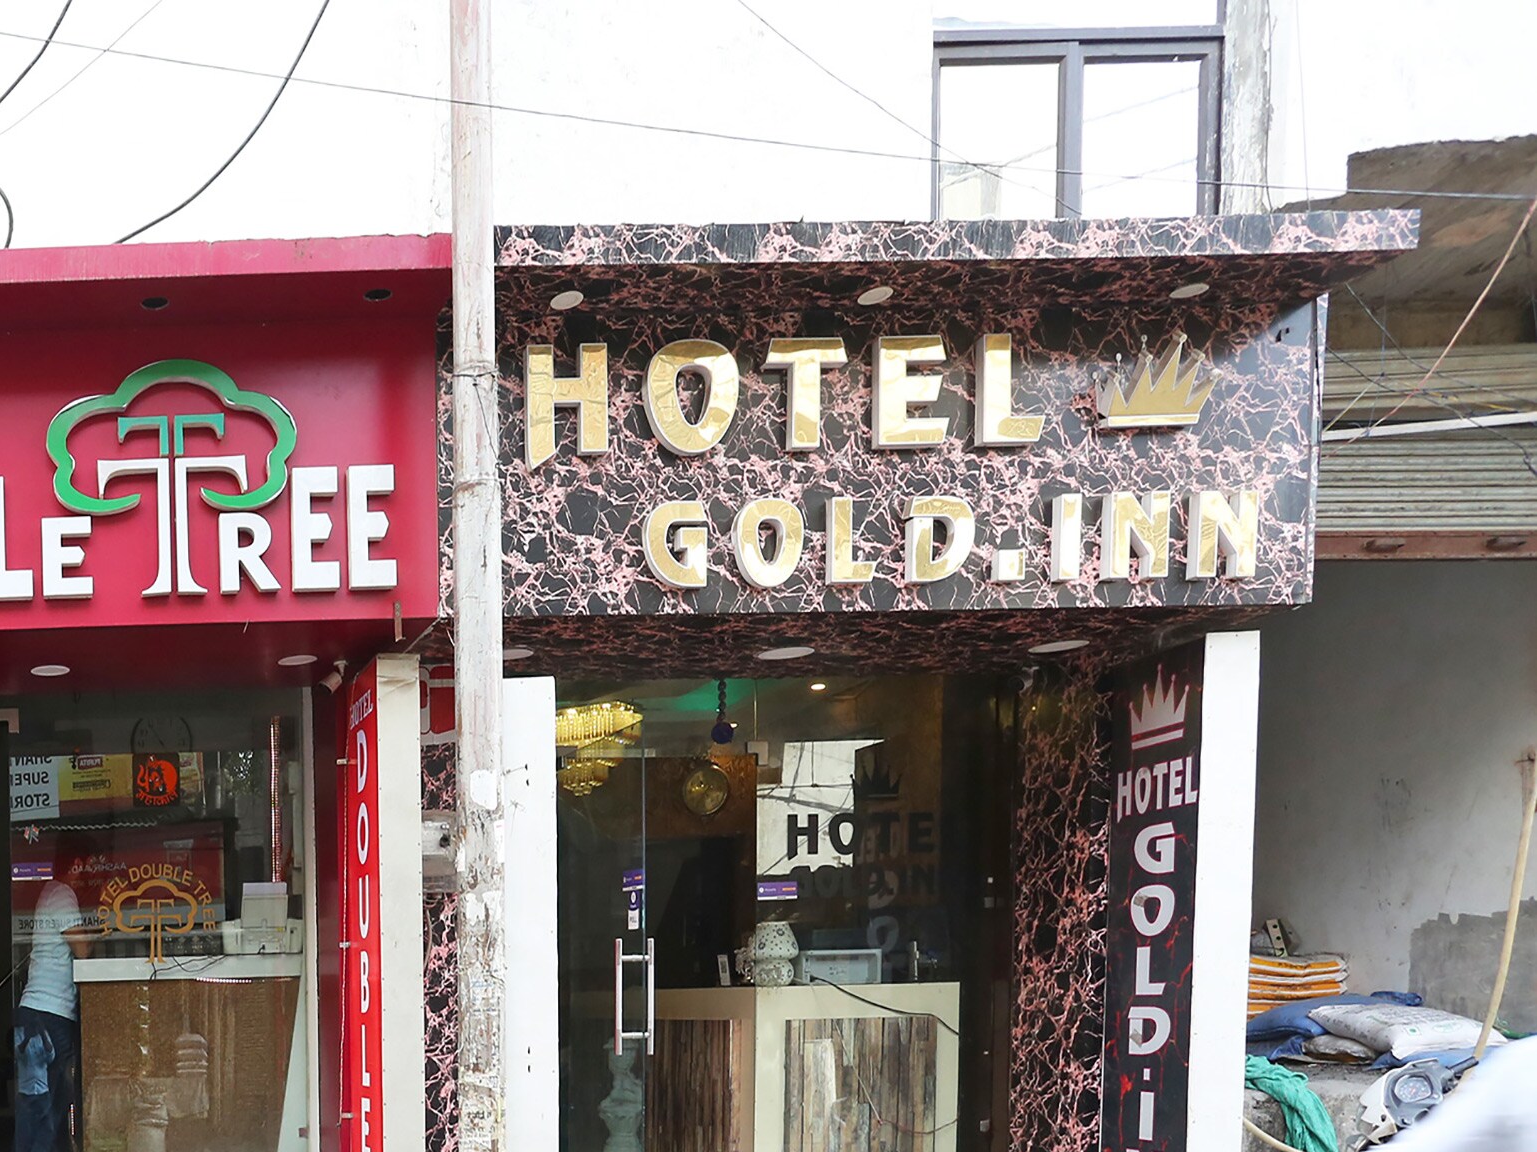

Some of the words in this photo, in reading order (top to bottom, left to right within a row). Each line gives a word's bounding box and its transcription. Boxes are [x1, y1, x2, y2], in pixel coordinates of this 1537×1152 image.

[525, 332, 1045, 471] HOTEL
[97, 455, 398, 597] TREE
[1116, 754, 1199, 822] HOTEL
[97, 877, 129, 936] HOTEL
[128, 863, 193, 886] DOUBLE
[193, 880, 216, 932] TREE
